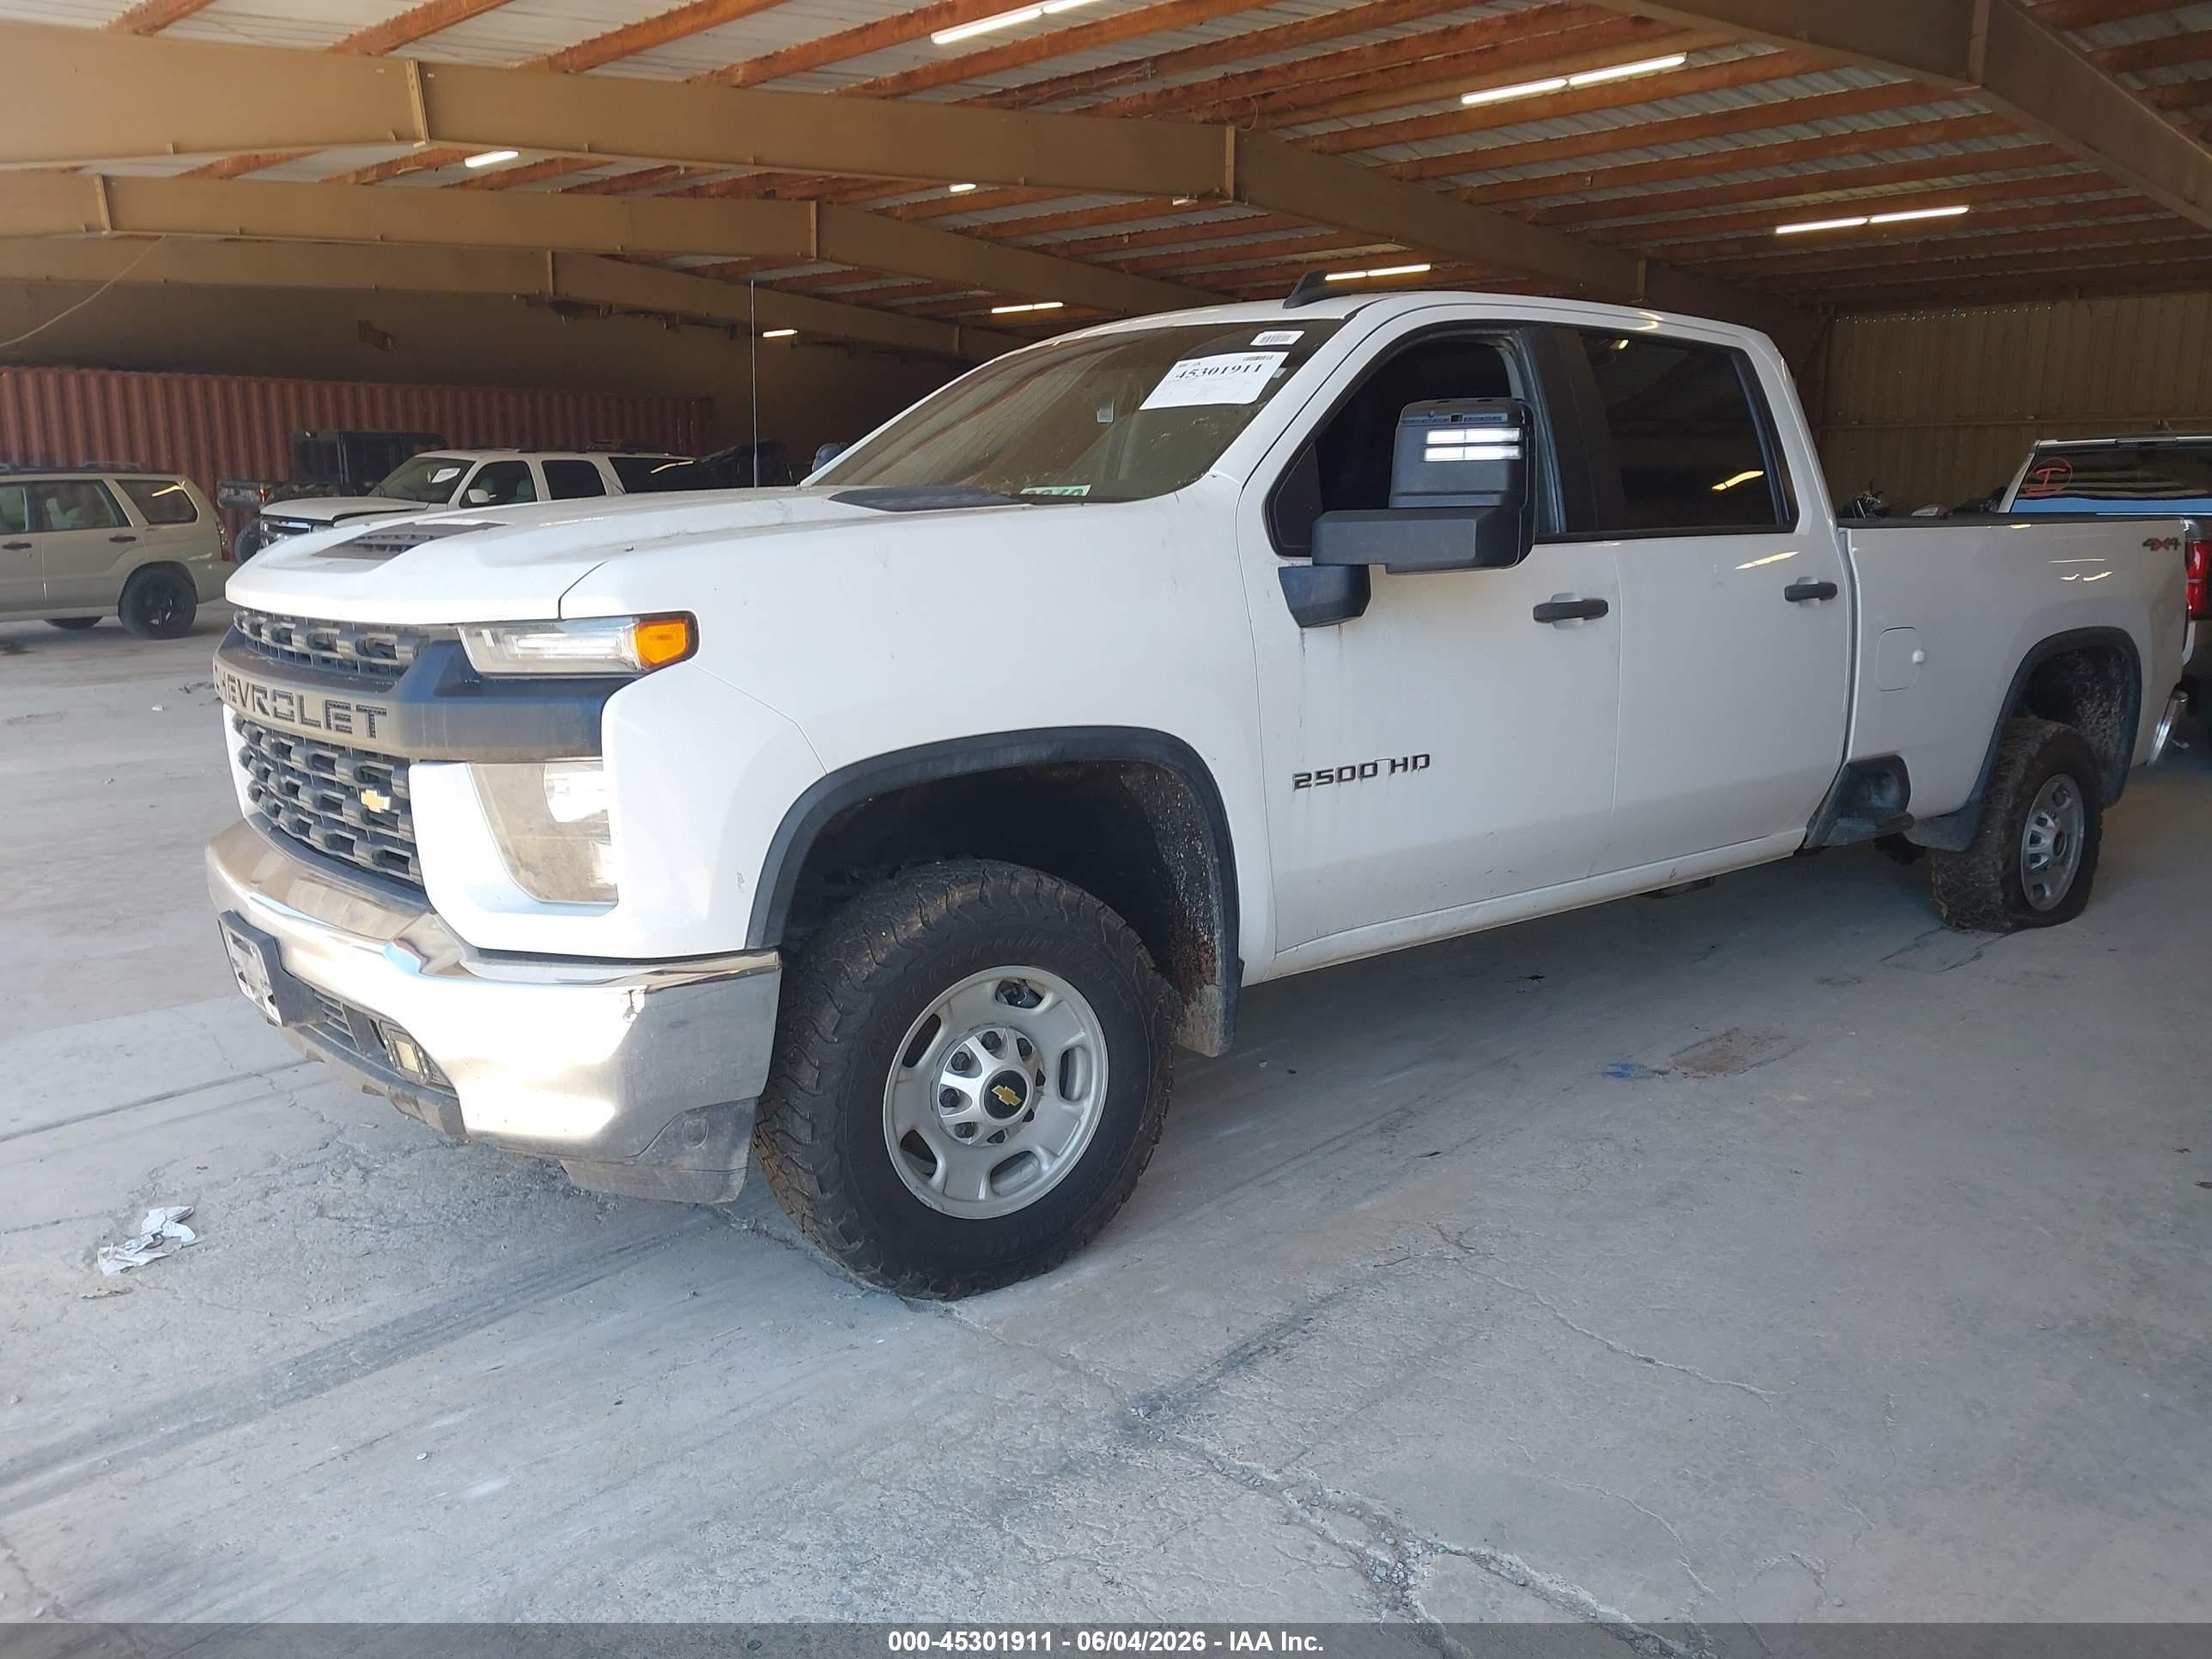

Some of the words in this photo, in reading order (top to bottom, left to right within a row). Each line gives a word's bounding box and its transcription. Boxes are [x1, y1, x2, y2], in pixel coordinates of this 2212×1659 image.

[1176, 364, 1263, 379] 45301911
[1291, 762, 1378, 791] 2500
[1389, 754, 1430, 776] HD
